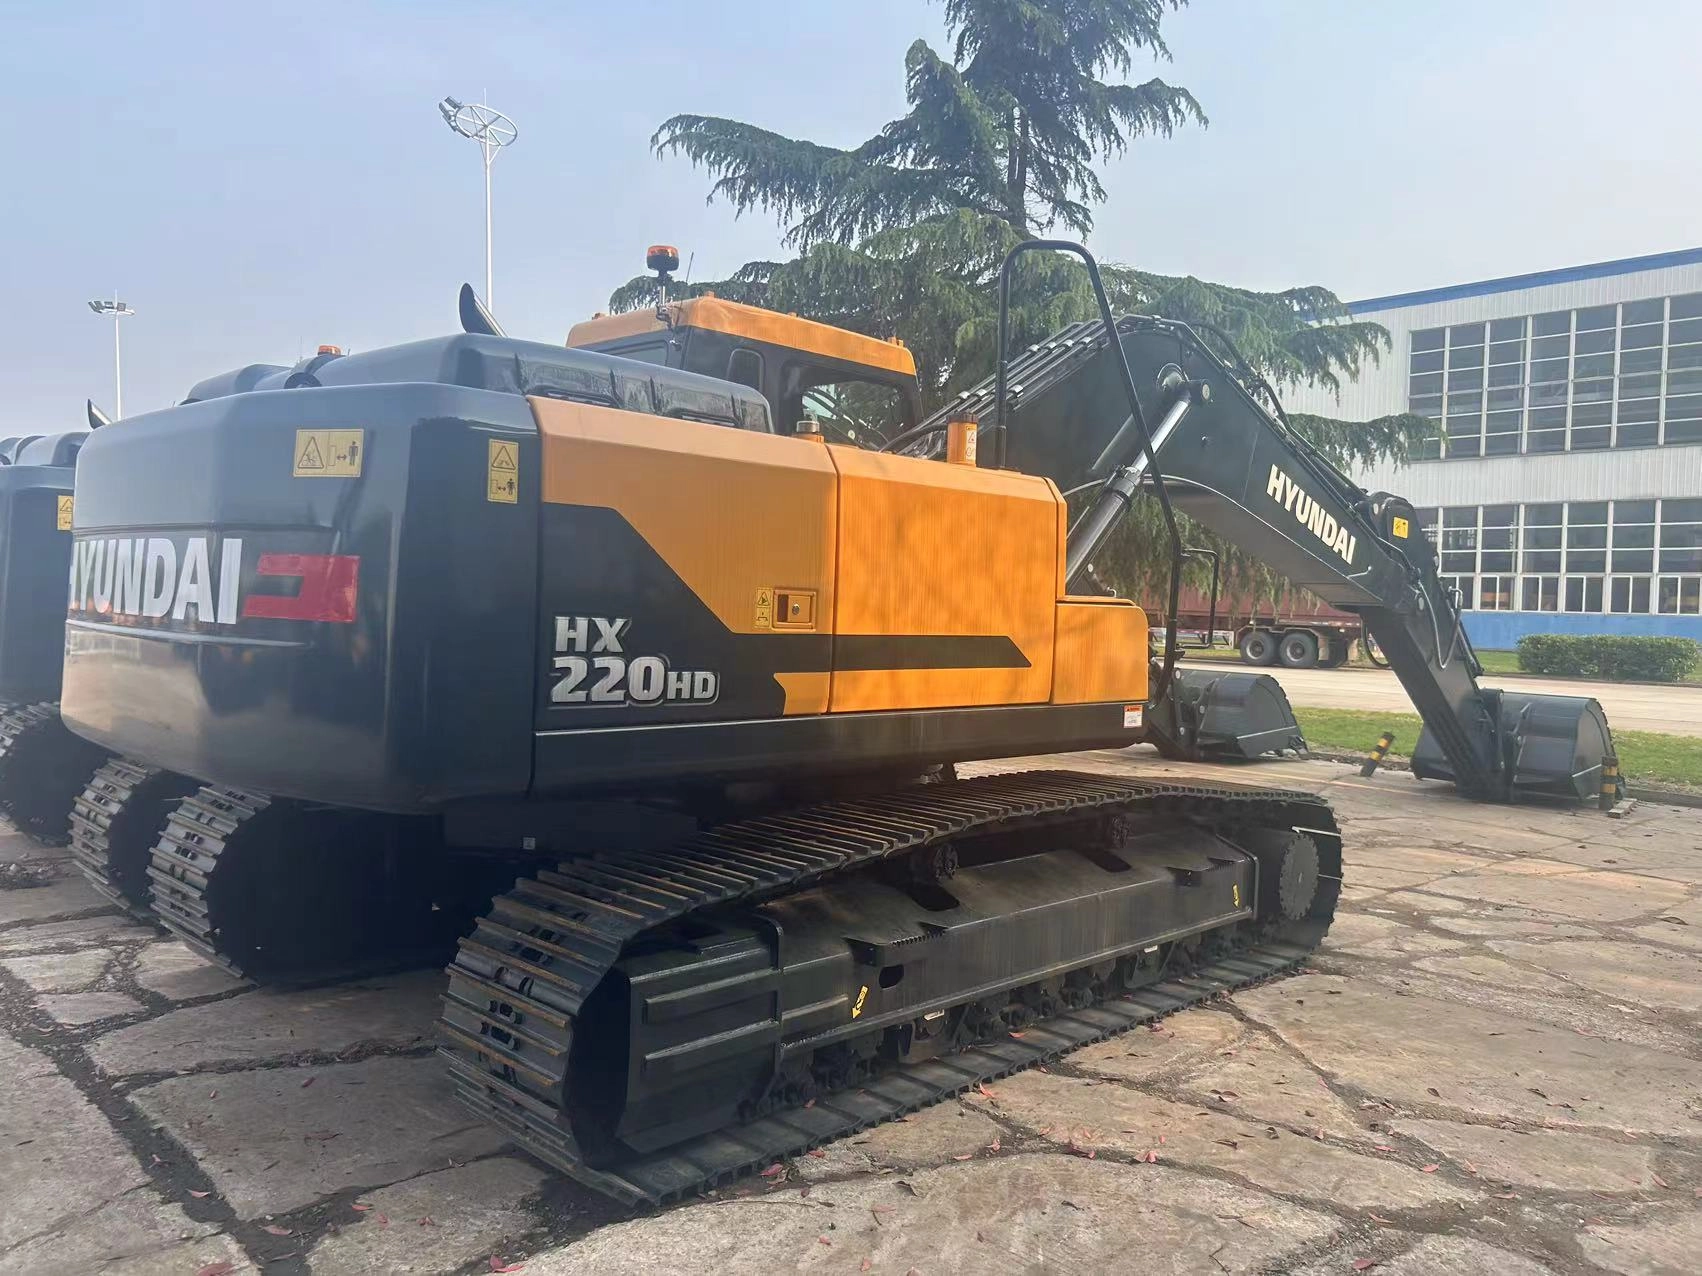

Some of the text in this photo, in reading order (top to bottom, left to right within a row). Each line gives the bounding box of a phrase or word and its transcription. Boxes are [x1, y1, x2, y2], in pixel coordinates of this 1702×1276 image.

[1266, 463, 1356, 565] HYUNDAI
[555, 616, 629, 653] HX
[551, 655, 717, 703] 220HD
